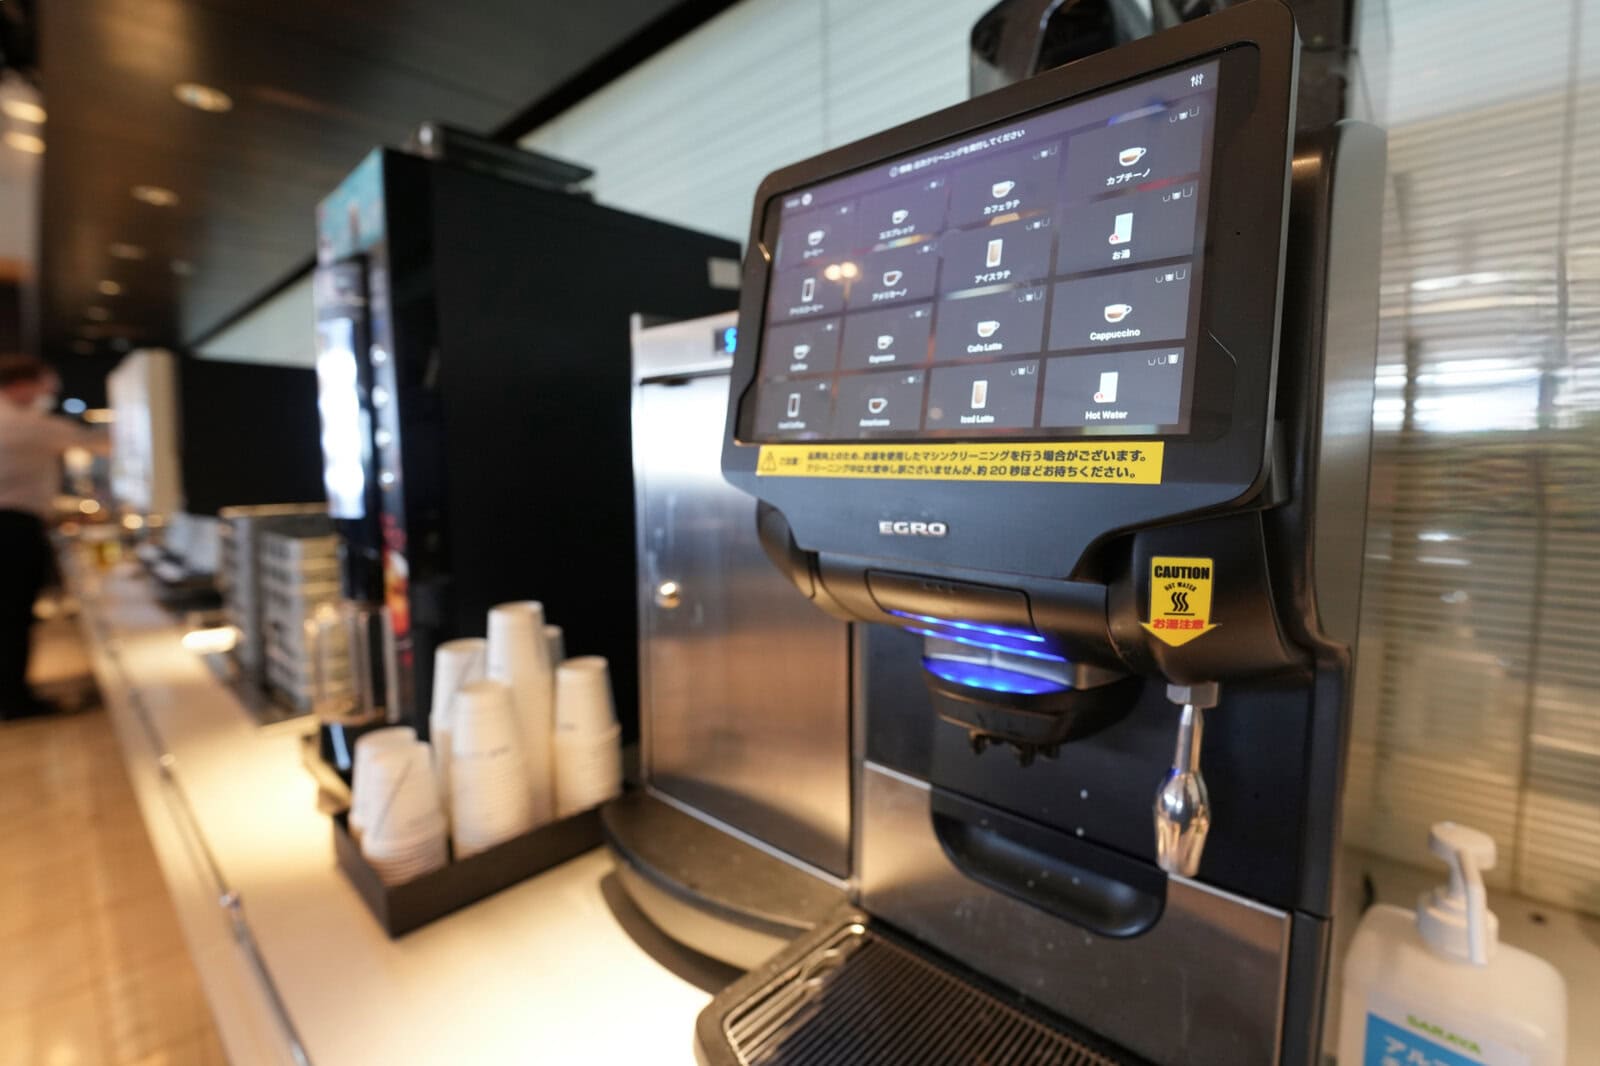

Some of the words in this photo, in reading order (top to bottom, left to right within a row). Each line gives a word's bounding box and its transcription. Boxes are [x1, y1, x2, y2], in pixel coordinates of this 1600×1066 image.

[1106, 168, 1151, 187] カプチーノ
[983, 199, 1021, 215] カフェラテ
[1111, 249, 1131, 261] お湯
[974, 269, 1012, 284] アイスラテ
[1089, 328, 1141, 341] Cappuccino
[984, 342, 1003, 352] Latte
[1085, 410, 1100, 421] Hot
[1101, 410, 1128, 420] Water
[878, 520, 948, 537] EGRO
[1154, 565, 1210, 580] CAUTION
[1164, 582, 1176, 591] HOT
[1177, 581, 1197, 592] WATER
[1153, 618, 1205, 630] お湯注意
